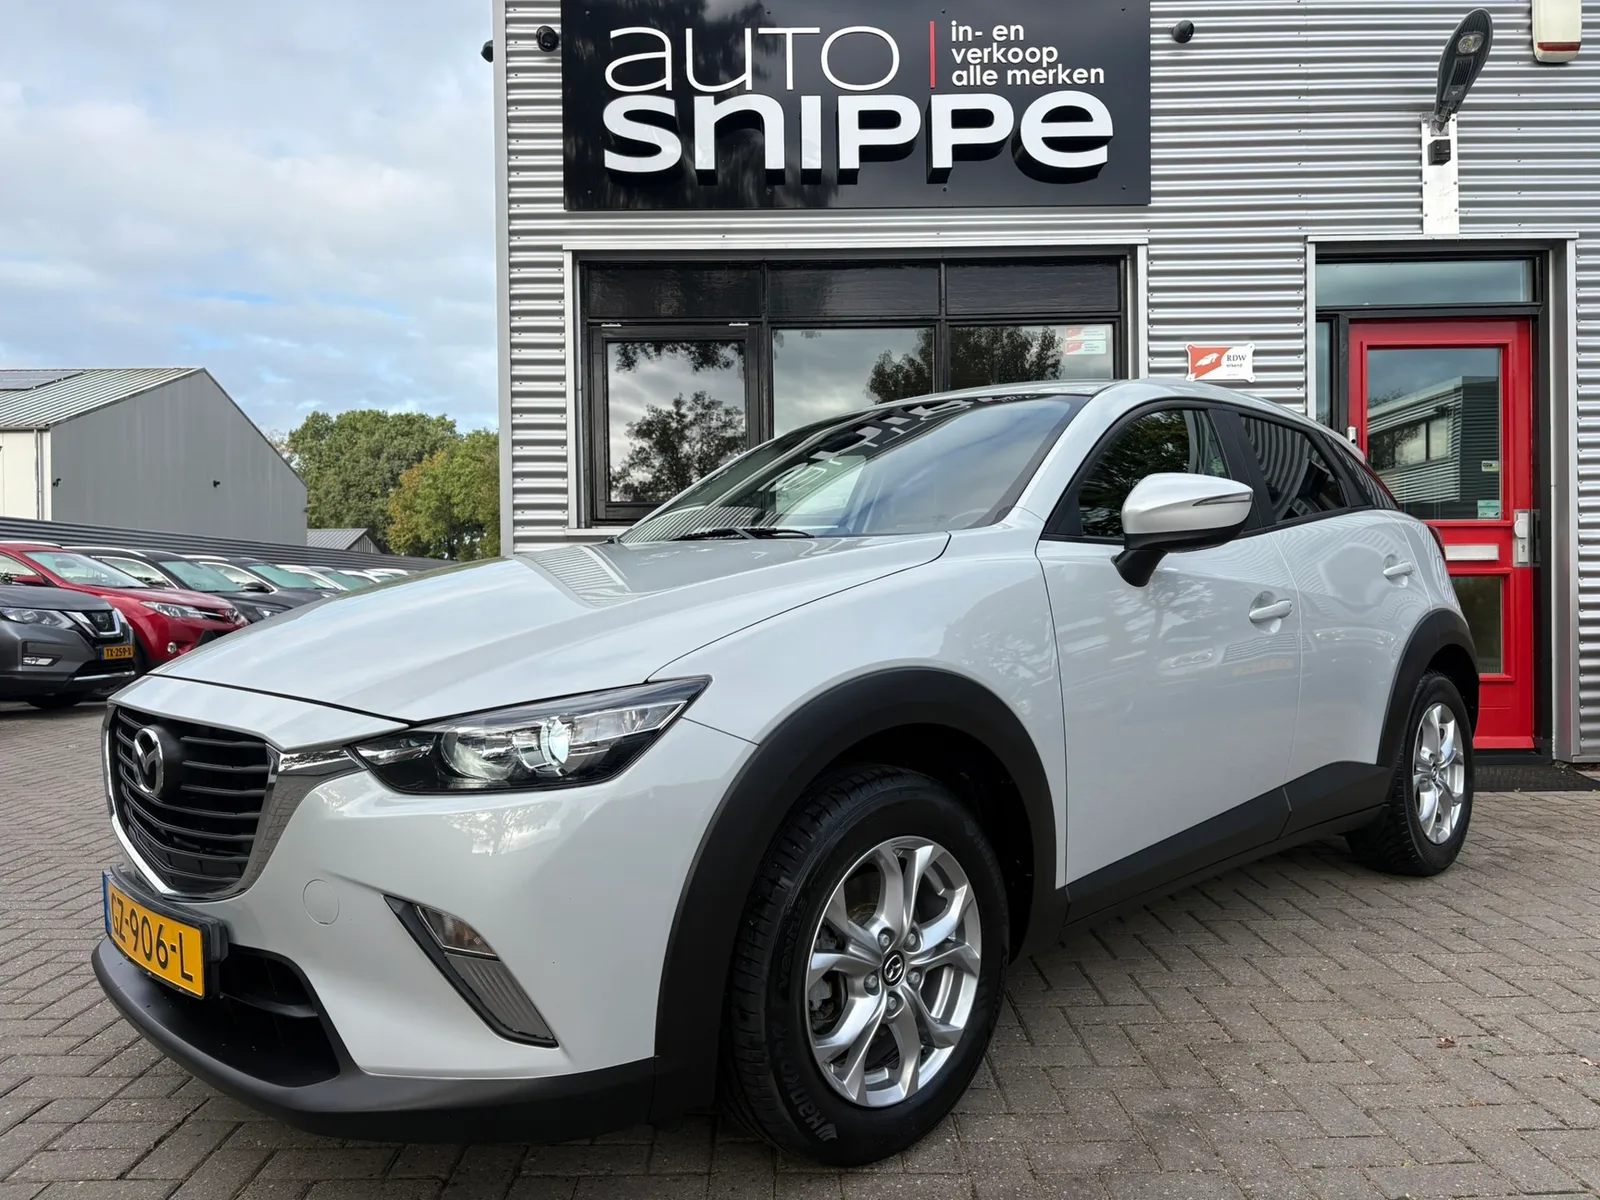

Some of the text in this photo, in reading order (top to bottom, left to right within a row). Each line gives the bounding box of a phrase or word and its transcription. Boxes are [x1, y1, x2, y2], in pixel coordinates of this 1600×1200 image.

[951, 20, 1025, 42] in- en
[951, 42, 1059, 67] verkoop
[952, 63, 1105, 86] alle merken
[1226, 354, 1247, 362] RDW
[105, 647, 132, 658] TX-259-X
[111, 892, 194, 983] GZ-906-L
